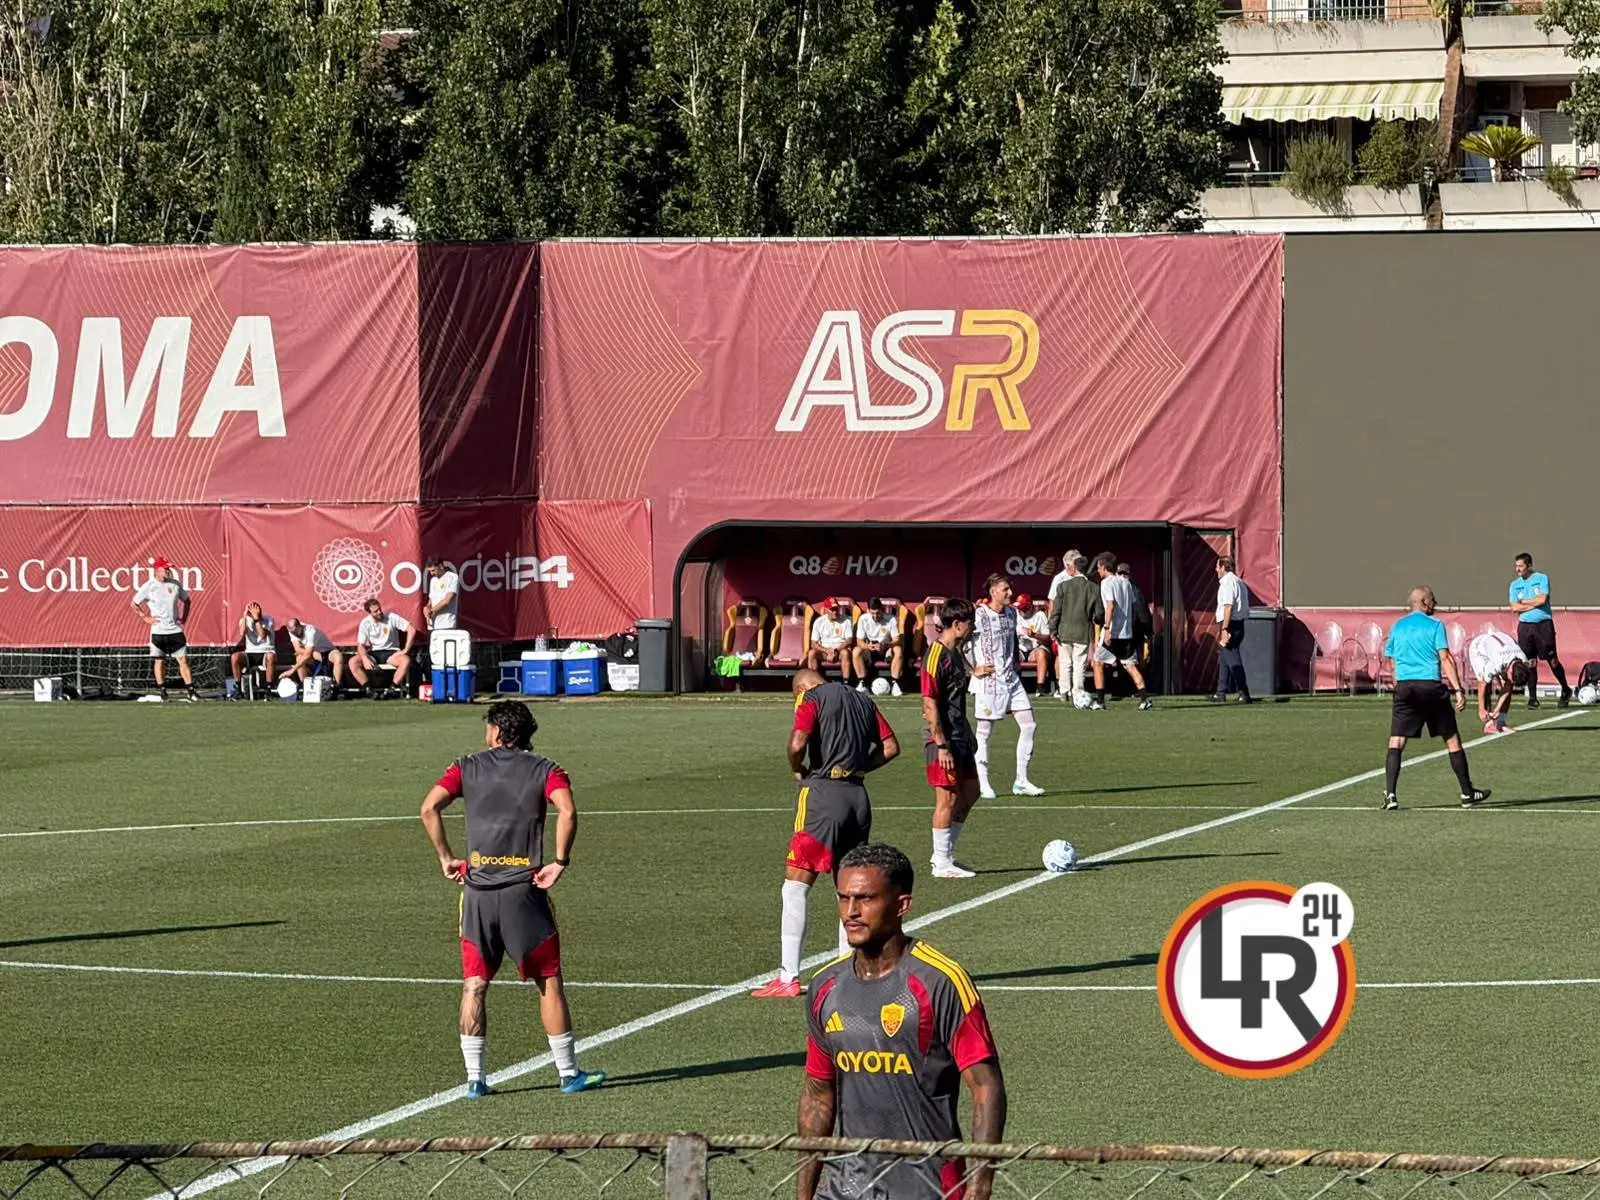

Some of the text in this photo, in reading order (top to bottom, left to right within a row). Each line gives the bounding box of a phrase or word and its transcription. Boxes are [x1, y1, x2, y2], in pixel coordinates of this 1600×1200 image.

[775, 309, 1040, 432] ASR
[789, 555, 899, 576] Q8 HVO
[1005, 555, 1038, 576] Q8
